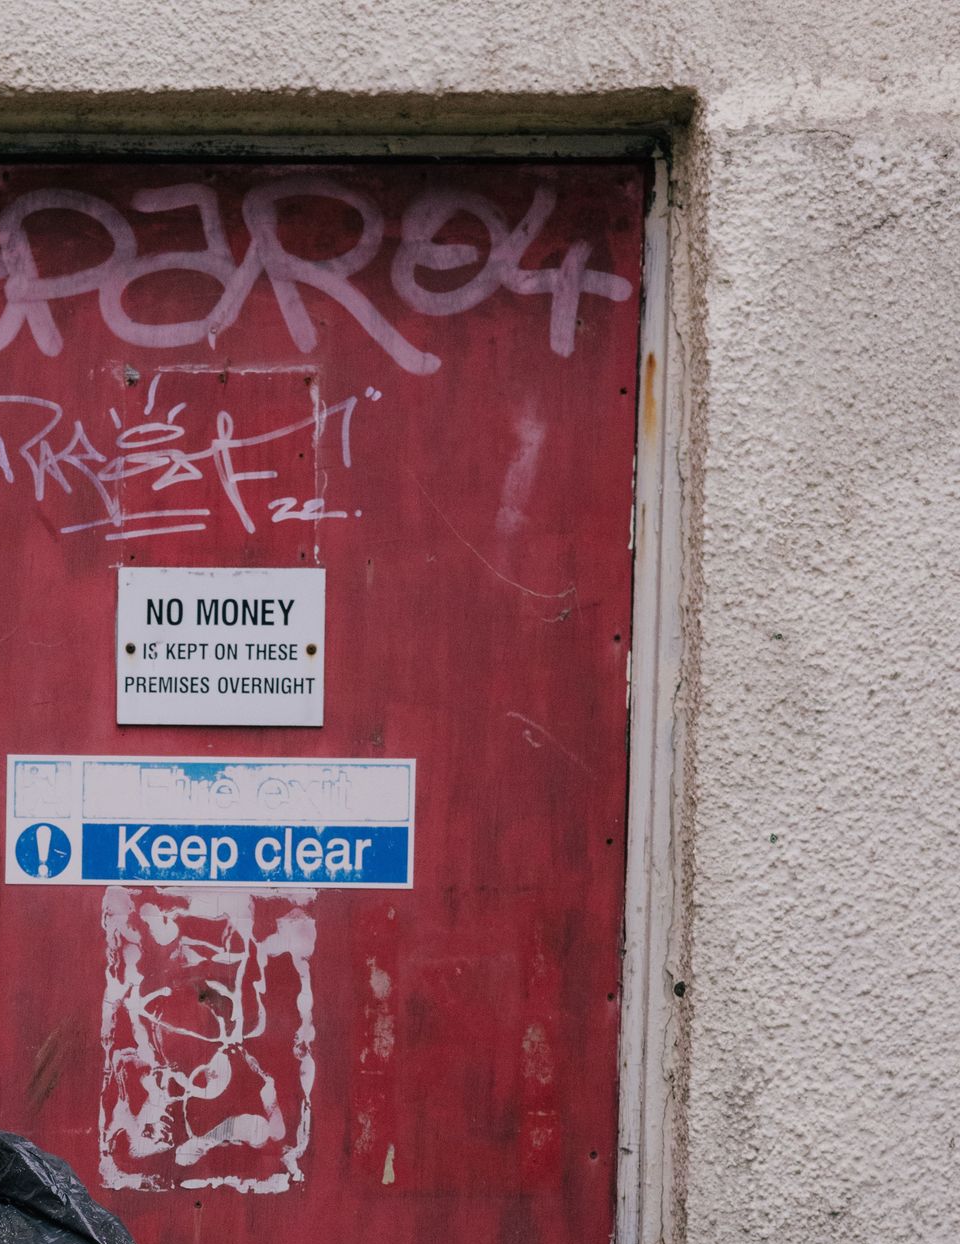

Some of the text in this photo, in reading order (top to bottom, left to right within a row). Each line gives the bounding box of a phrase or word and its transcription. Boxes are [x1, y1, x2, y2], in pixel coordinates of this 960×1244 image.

[145, 598, 296, 626] NO MONEY
[142, 643, 299, 661] IS KEPT ON THESE
[124, 676, 316, 695] PREMISES OVERNIGHT
[117, 826, 372, 880] Keep clear
